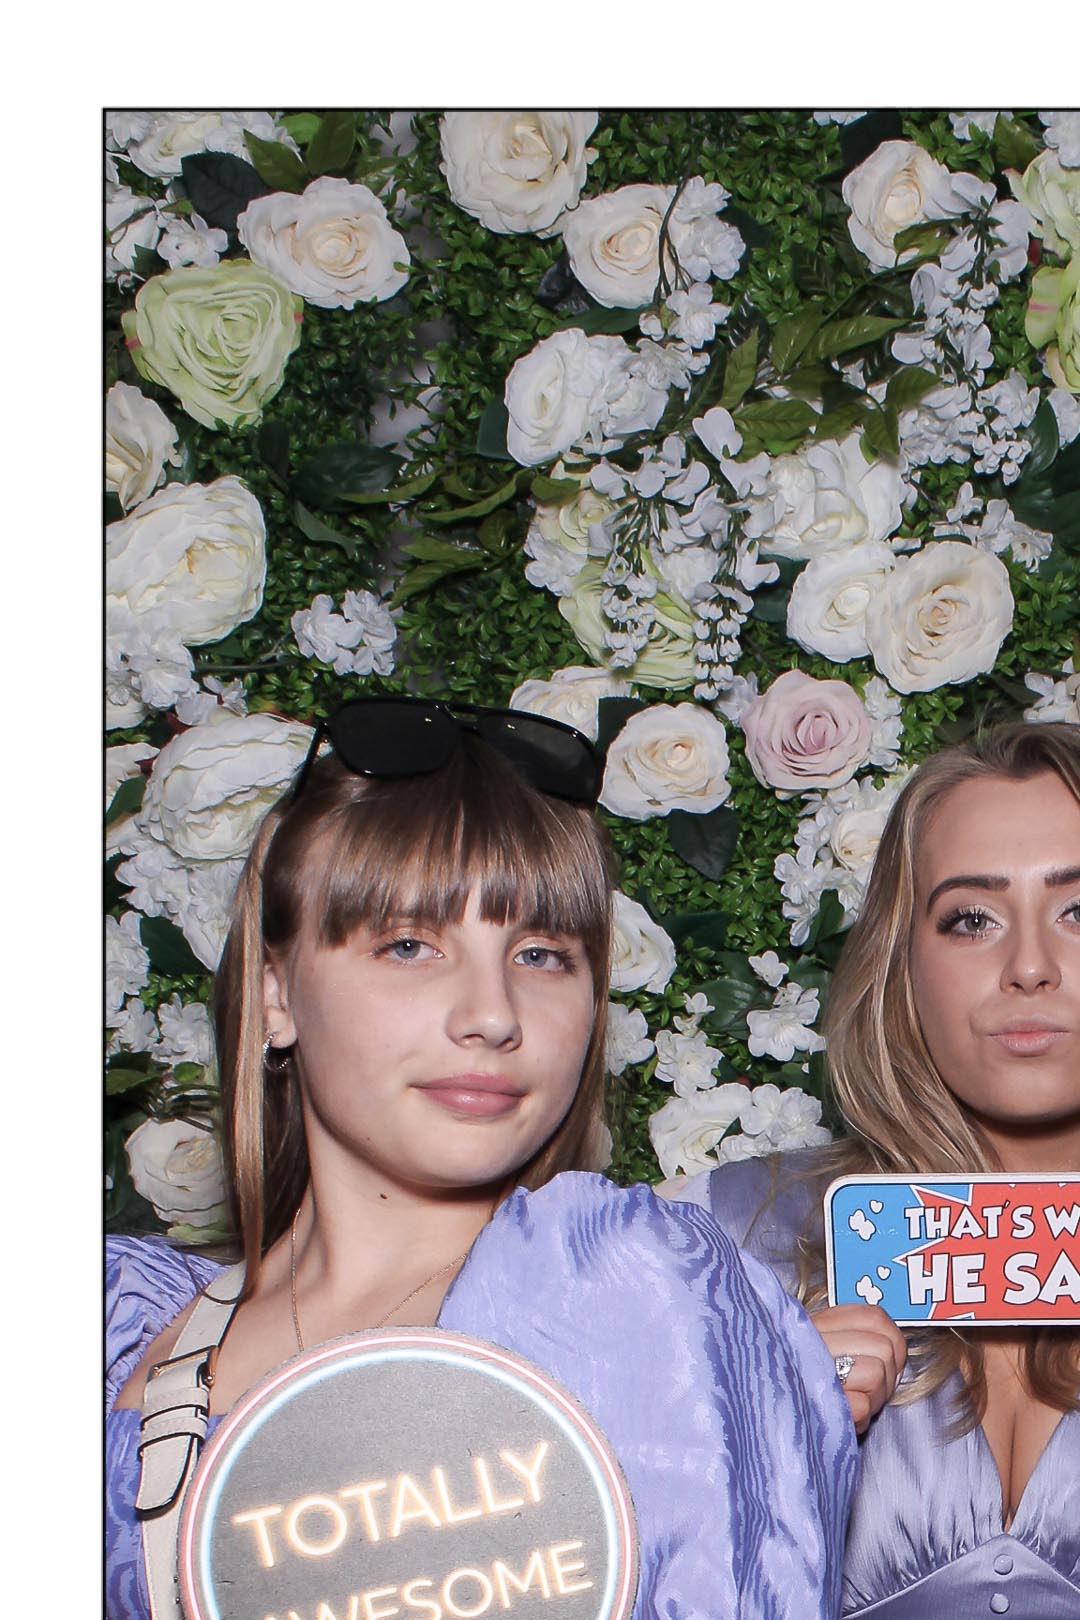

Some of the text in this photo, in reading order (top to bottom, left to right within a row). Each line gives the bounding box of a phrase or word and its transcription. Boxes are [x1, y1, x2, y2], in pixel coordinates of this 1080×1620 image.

[903, 1201, 1035, 1241] THAT'S
[907, 1253, 986, 1305] HE
[233, 1441, 551, 1568] TOTALLY
